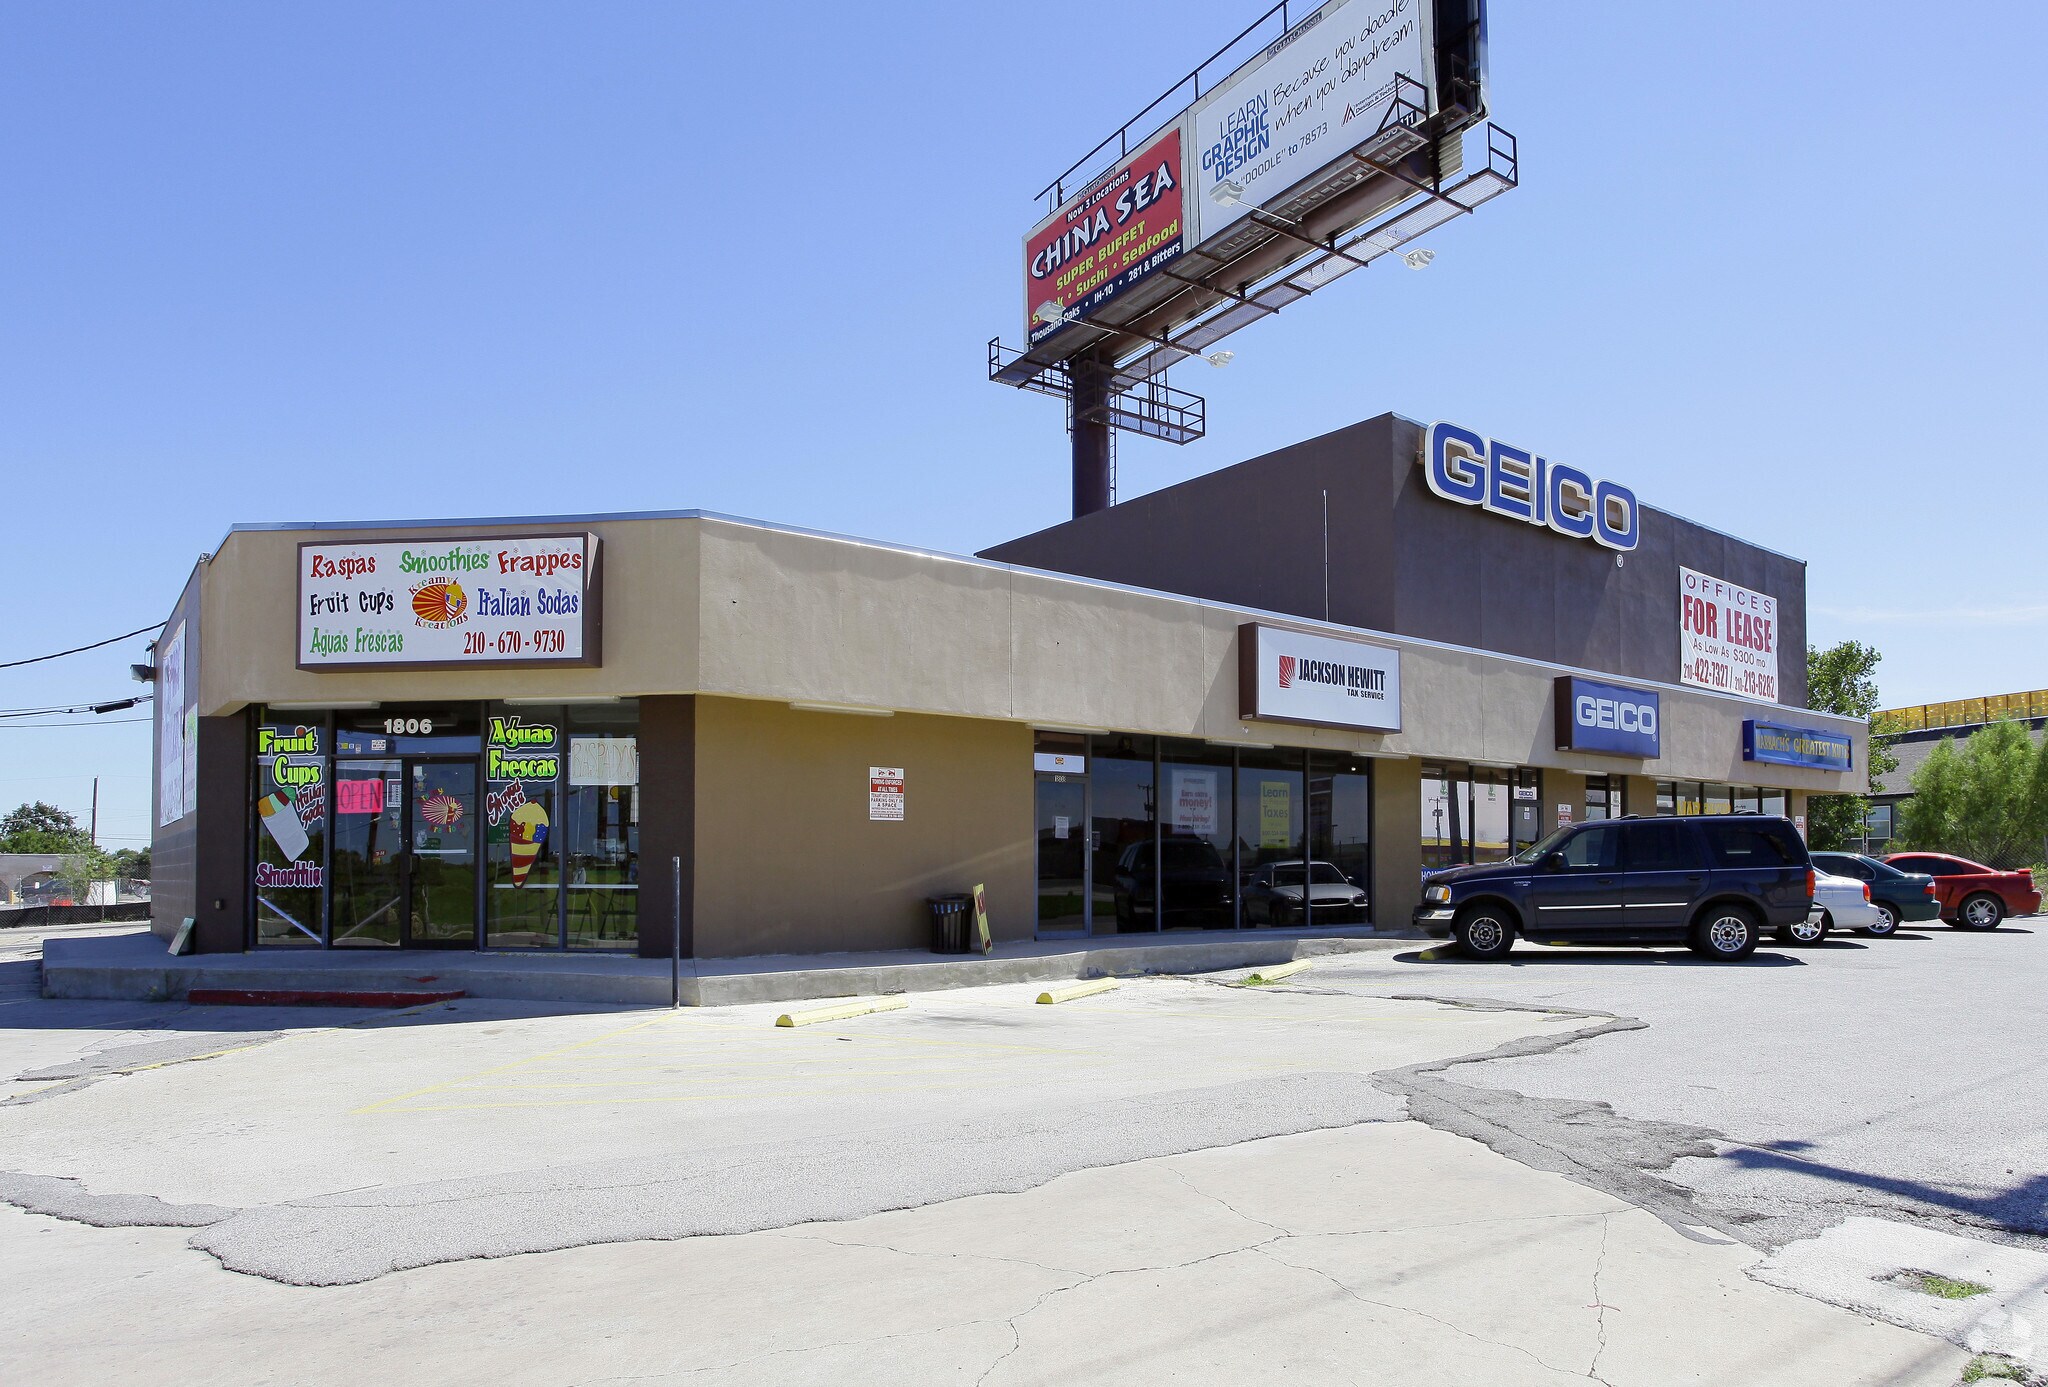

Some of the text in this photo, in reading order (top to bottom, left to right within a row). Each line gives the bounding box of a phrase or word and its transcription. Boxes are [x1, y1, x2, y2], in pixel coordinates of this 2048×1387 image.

[1273, 57, 1330, 105] Because
[1335, 36, 1356, 70] you
[1360, 0, 1410, 42] doodle
[1275, 94, 1312, 131] when
[1317, 77, 1336, 111] you
[1341, 19, 1414, 81] daydream
[1220, 89, 1268, 140] LEARN
[1202, 109, 1270, 171] GRAPHIC
[1215, 129, 1270, 183] DESIGN
[1288, 144, 1298, 157] to
[1300, 122, 1328, 149] 78573
[1067, 171, 1130, 223] Now 3 Locations
[1031, 162, 1174, 279] CHINA SEA
[1056, 220, 1147, 291] SUPER BUFFET
[1076, 219, 1179, 297] Sushi Seafood
[1094, 283, 1114, 304] IH-10
[1128, 265, 1143, 282] 281
[1144, 260, 1151, 272] &
[1152, 242, 1181, 268] Bitters
[1424, 419, 1640, 552] GEICO
[310, 546, 582, 580] Raspas Smoothies Frappes
[408, 576, 453, 595] Kreamy
[476, 587, 578, 617] Italian Sodas
[1685, 574, 1772, 614] OFFICES
[310, 589, 394, 616] Fruit Cups
[415, 612, 469, 630] Kreations
[1683, 594, 1772, 654] FOR LEASE
[310, 627, 404, 657] Aguas Frescas
[1693, 638, 1703, 652] As
[1705, 641, 1719, 655] Low
[1721, 645, 1730, 659] As
[1733, 648, 1755, 666] $300
[1298, 658, 1385, 691] JACKSON HEWITT
[1346, 688, 1385, 701] TAX SERVICE
[384, 718, 432, 734] 1806
[1576, 694, 1657, 735] GEICO
[259, 726, 316, 753] Fruit
[491, 719, 553, 748] Aguas
[1793, 738, 1831, 757] GREATEST
[274, 756, 320, 787] Cups
[489, 749, 557, 778] Frescas
[571, 742, 637, 779] RASPADOS
[340, 782, 382, 810] OPEN
[1262, 784, 1288, 798] Learn
[1262, 804, 1288, 818] Taxes
[255, 861, 323, 887] Smoothie
